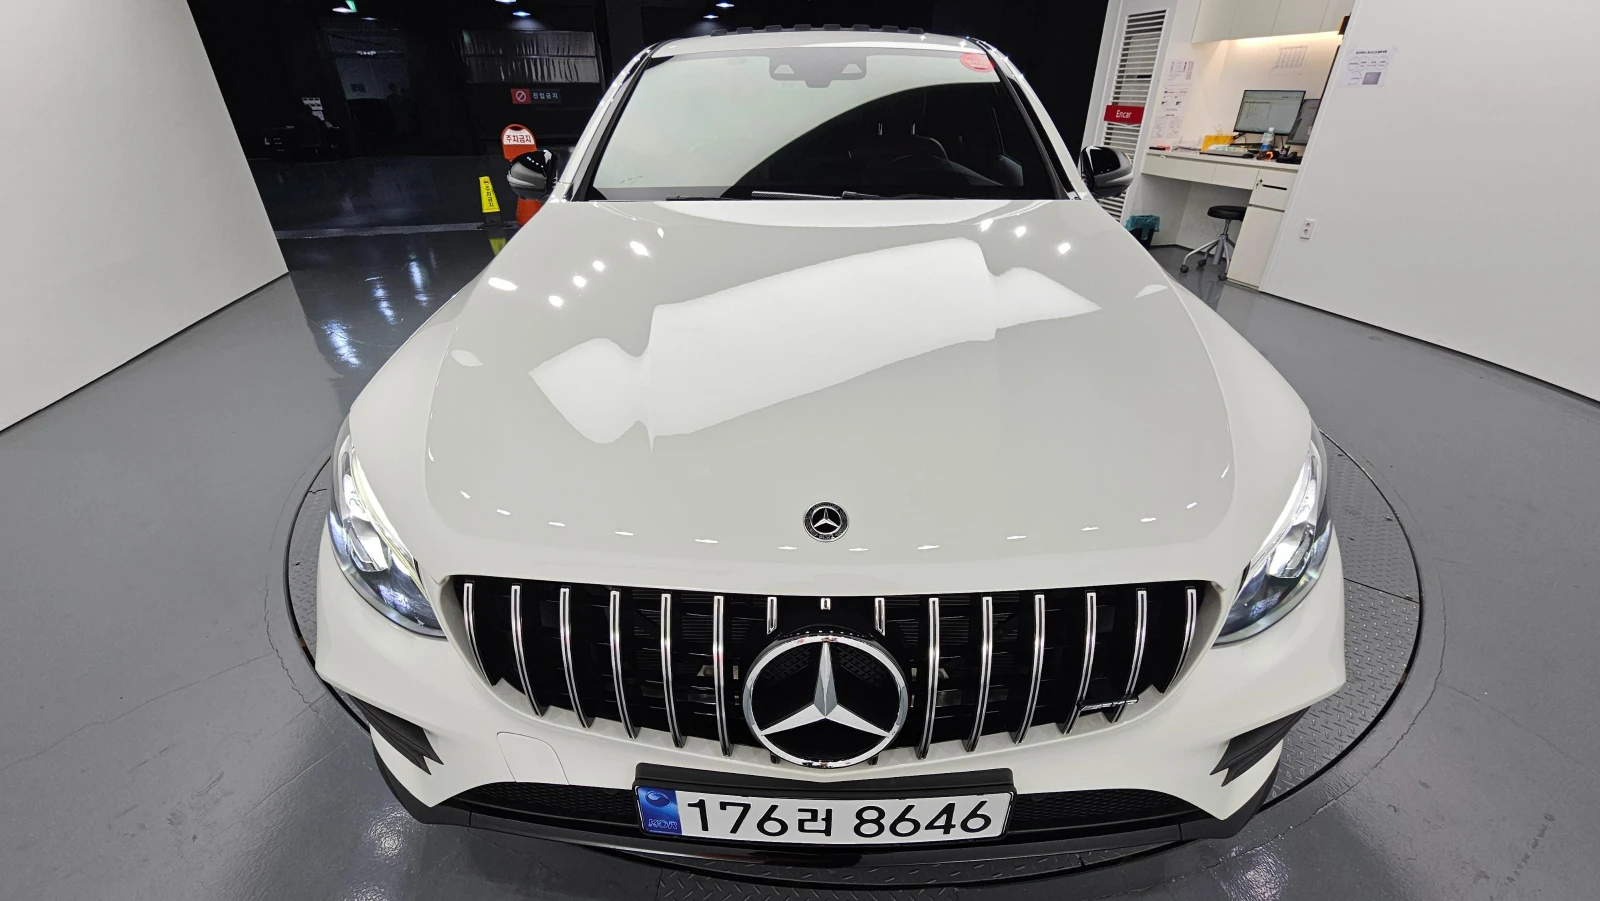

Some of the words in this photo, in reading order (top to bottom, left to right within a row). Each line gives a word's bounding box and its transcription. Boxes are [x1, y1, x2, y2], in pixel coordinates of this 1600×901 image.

[533, 92, 558, 100] 진입금지
[1116, 109, 1132, 119] Encar
[506, 134, 532, 143] 주차금지
[688, 799, 833, 837] 176러
[853, 800, 992, 838] 8646
[648, 818, 678, 831] KOR
